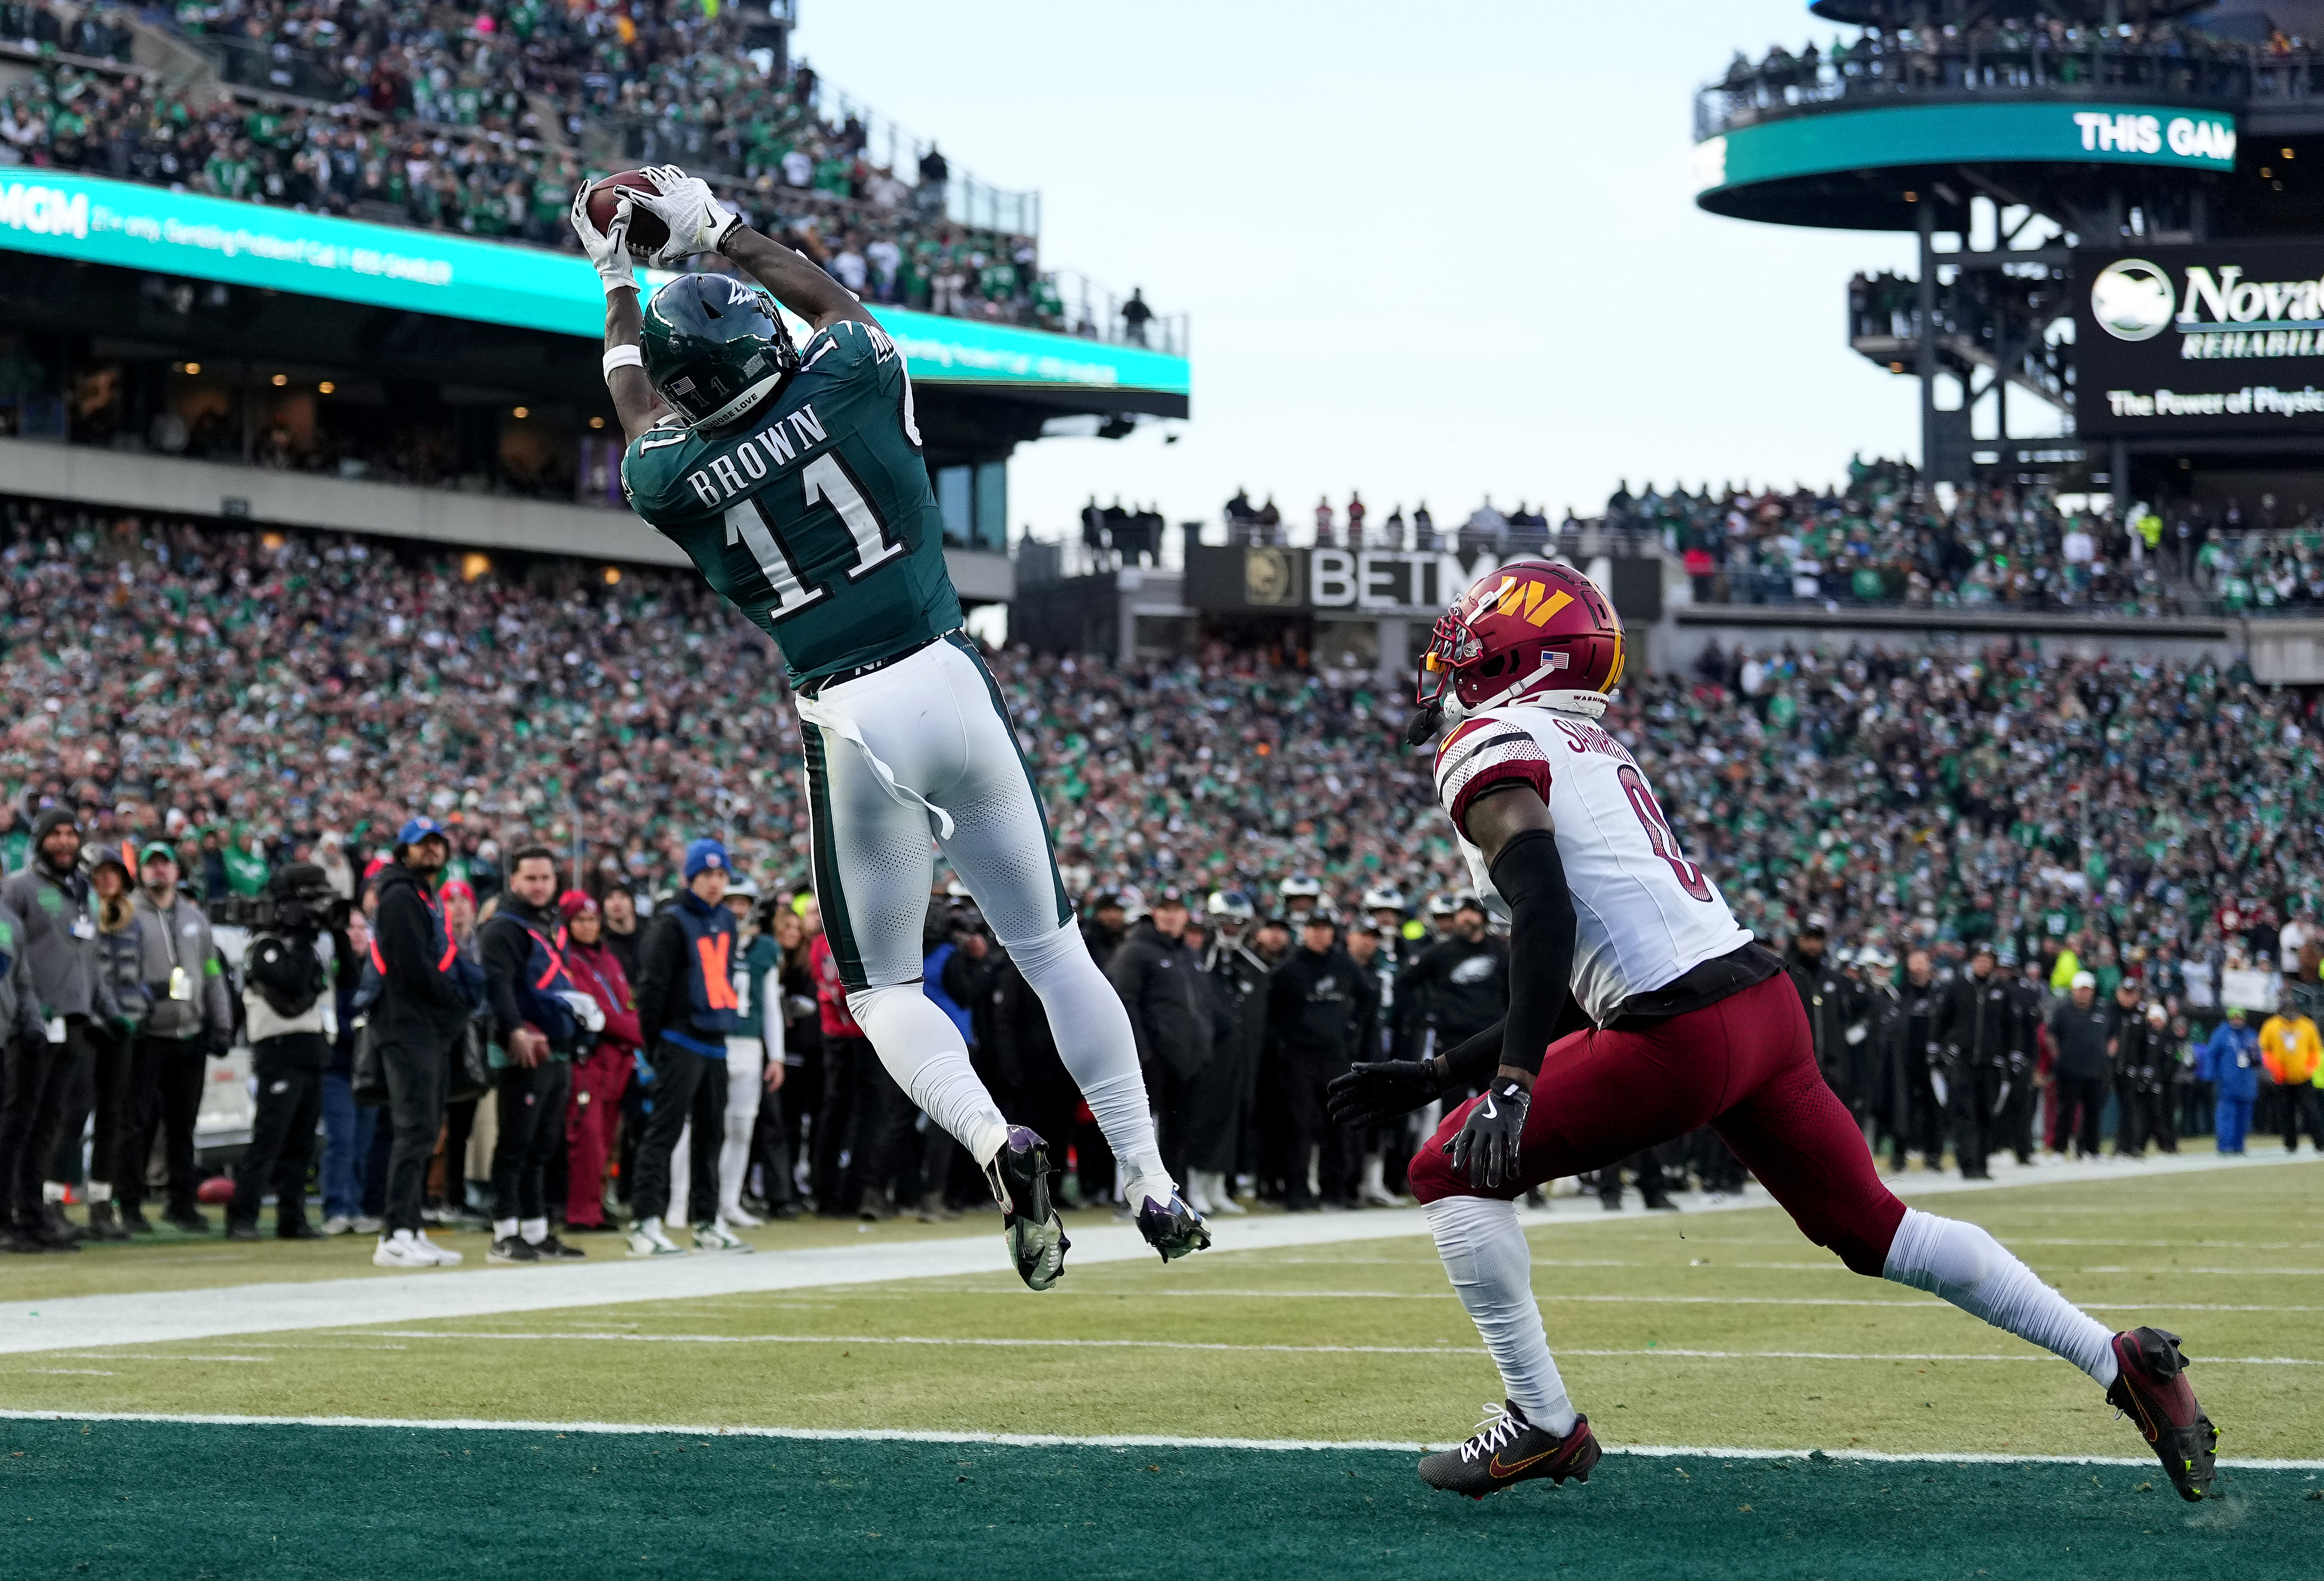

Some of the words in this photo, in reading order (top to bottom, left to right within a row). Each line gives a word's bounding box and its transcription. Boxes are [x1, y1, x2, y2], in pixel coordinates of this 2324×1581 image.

[2073, 112, 2162, 154] THIS
[691, 375, 730, 407] 11
[703, 411, 736, 429] CHOOSE
[735, 393, 758, 412] LOVE
[2105, 390, 2154, 416] The
[2155, 389, 2224, 416] Power
[2225, 387, 2253, 414] of
[687, 404, 828, 508] BROWN
[725, 451, 903, 619] 11
[1617, 764, 1713, 902] 0
